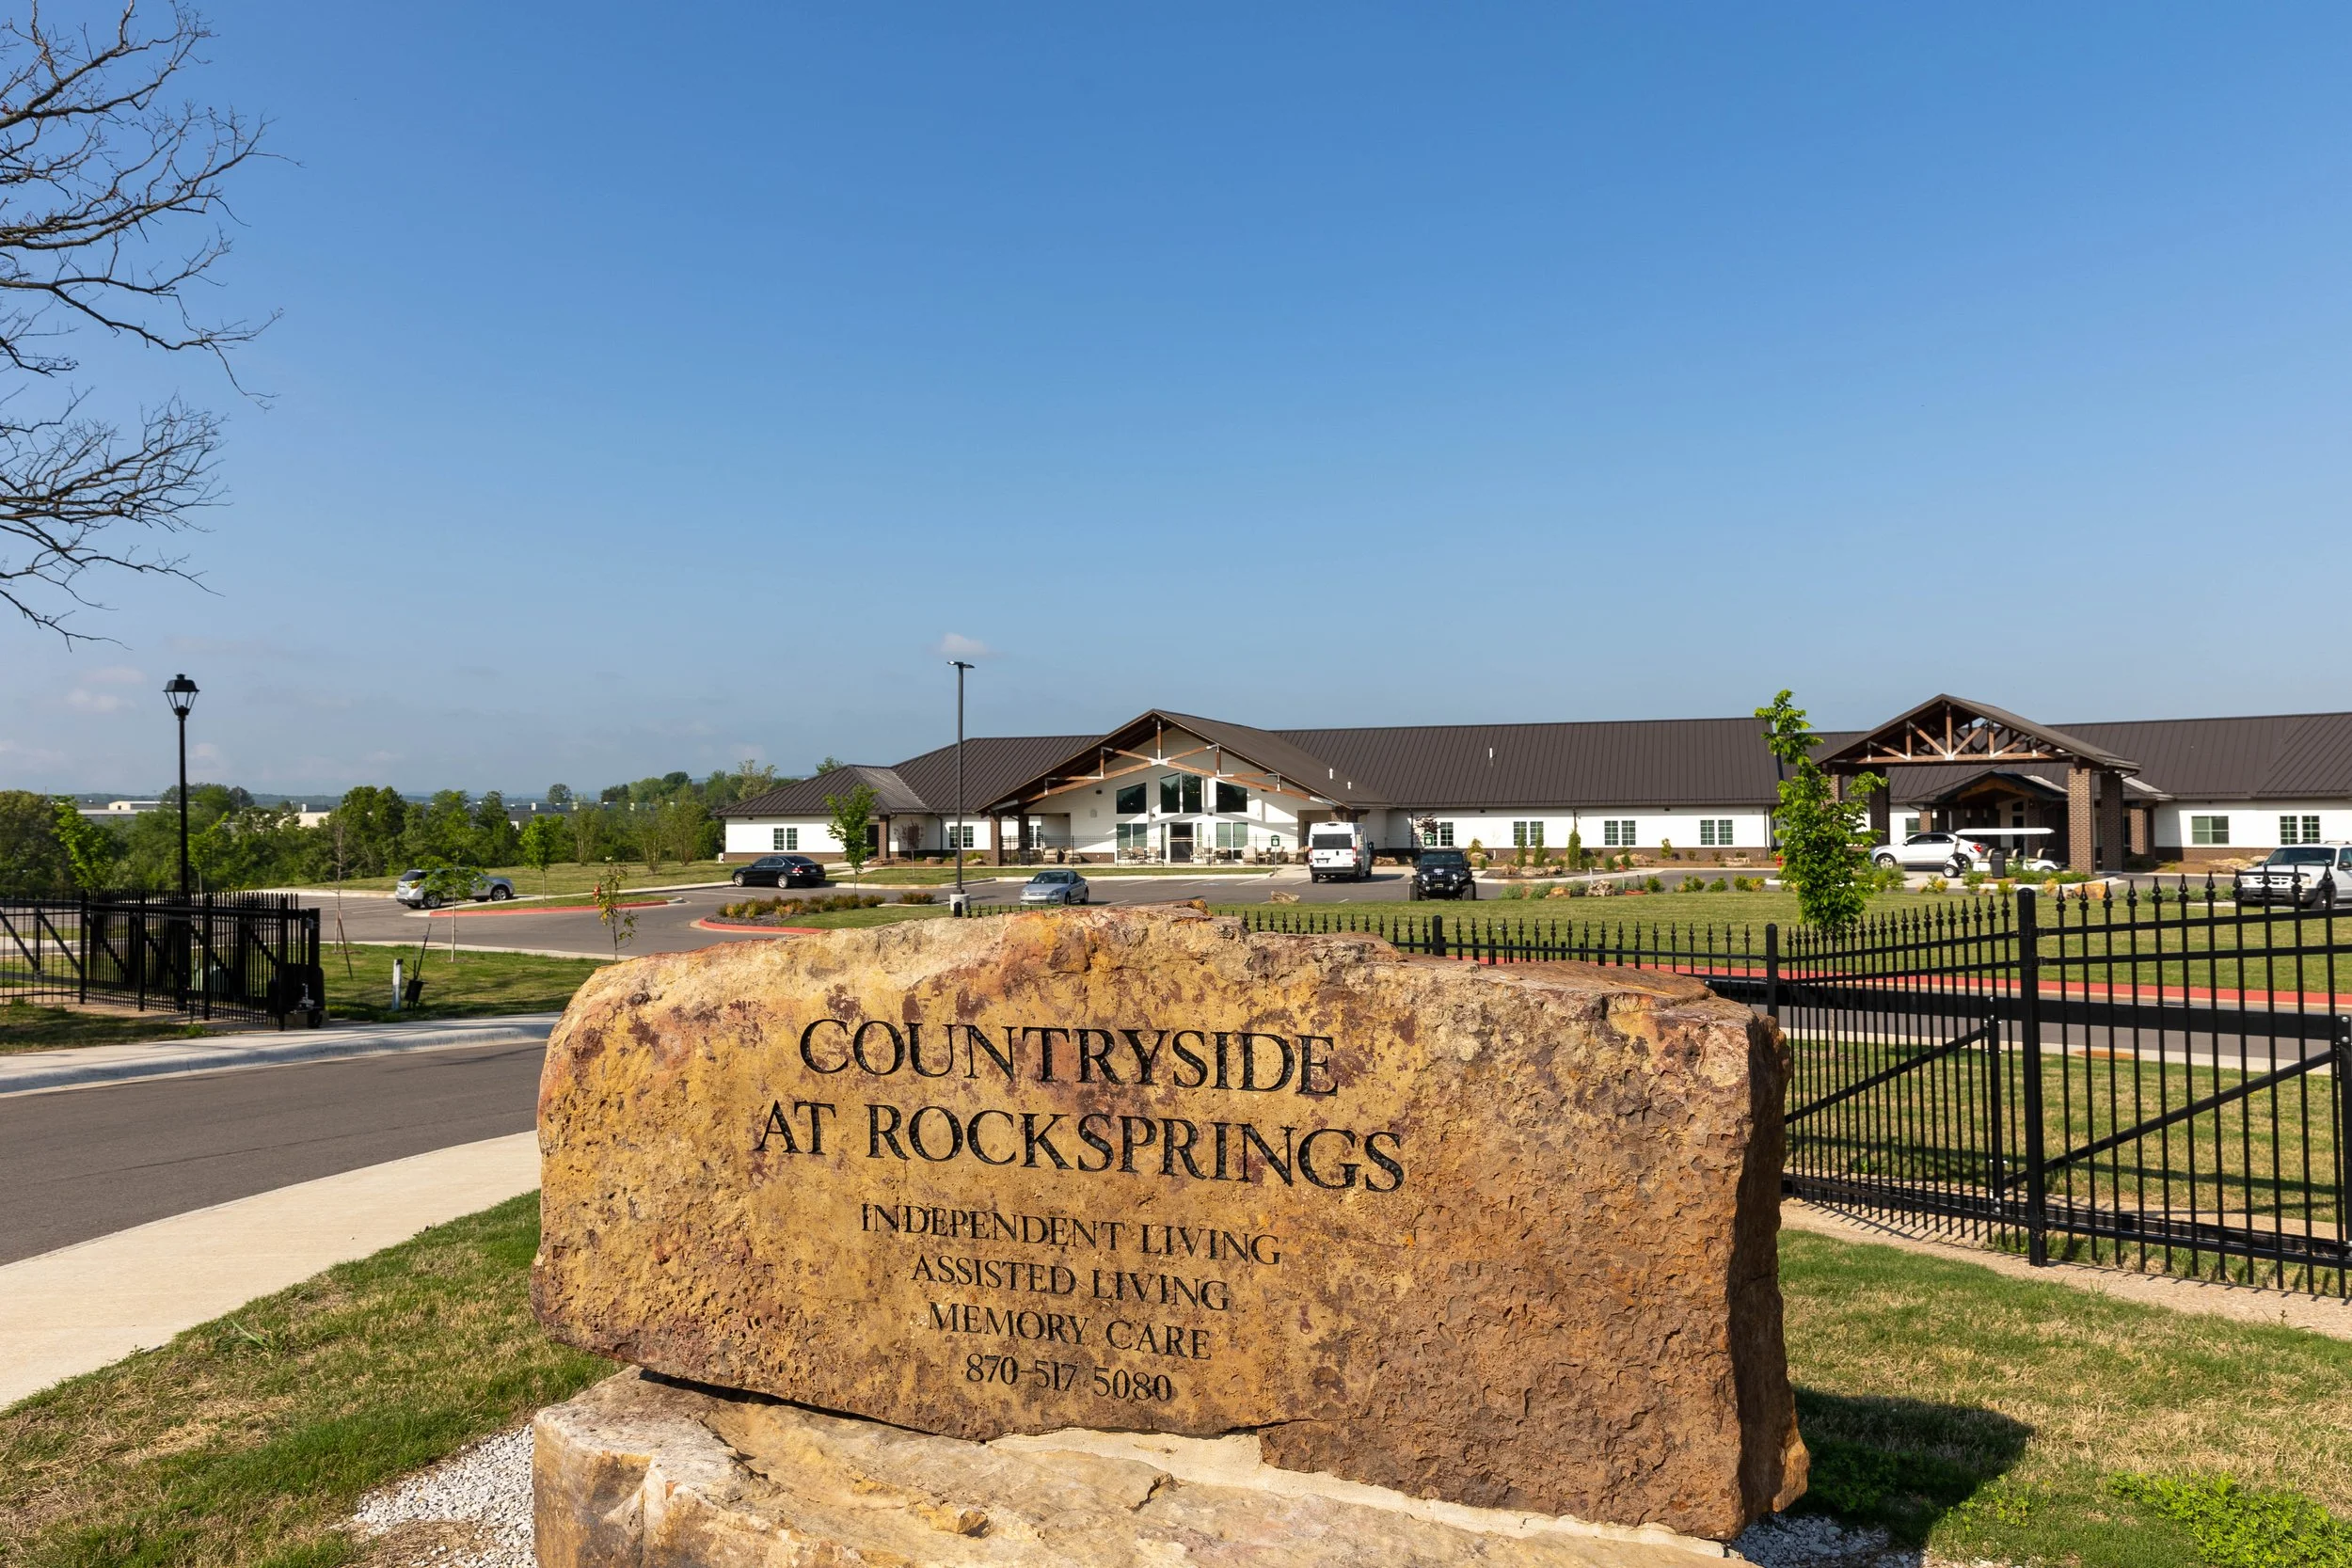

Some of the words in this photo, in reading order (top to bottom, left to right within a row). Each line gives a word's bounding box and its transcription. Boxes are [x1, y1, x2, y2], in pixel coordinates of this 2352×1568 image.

[799, 1019, 1340, 1097] COUNTRYSIDE
[755, 1100, 835, 1156] AT
[866, 1104, 1404, 1192] ROCKSPRINGS
[861, 1203, 1125, 1250] INDEPENDENT
[1140, 1225, 1280, 1265] LIVING
[911, 1255, 1075, 1295] ASSISTED
[1091, 1274, 1231, 1311] LIVING
[929, 1302, 1091, 1345] MEMORY
[1104, 1319, 1212, 1360] CARE
